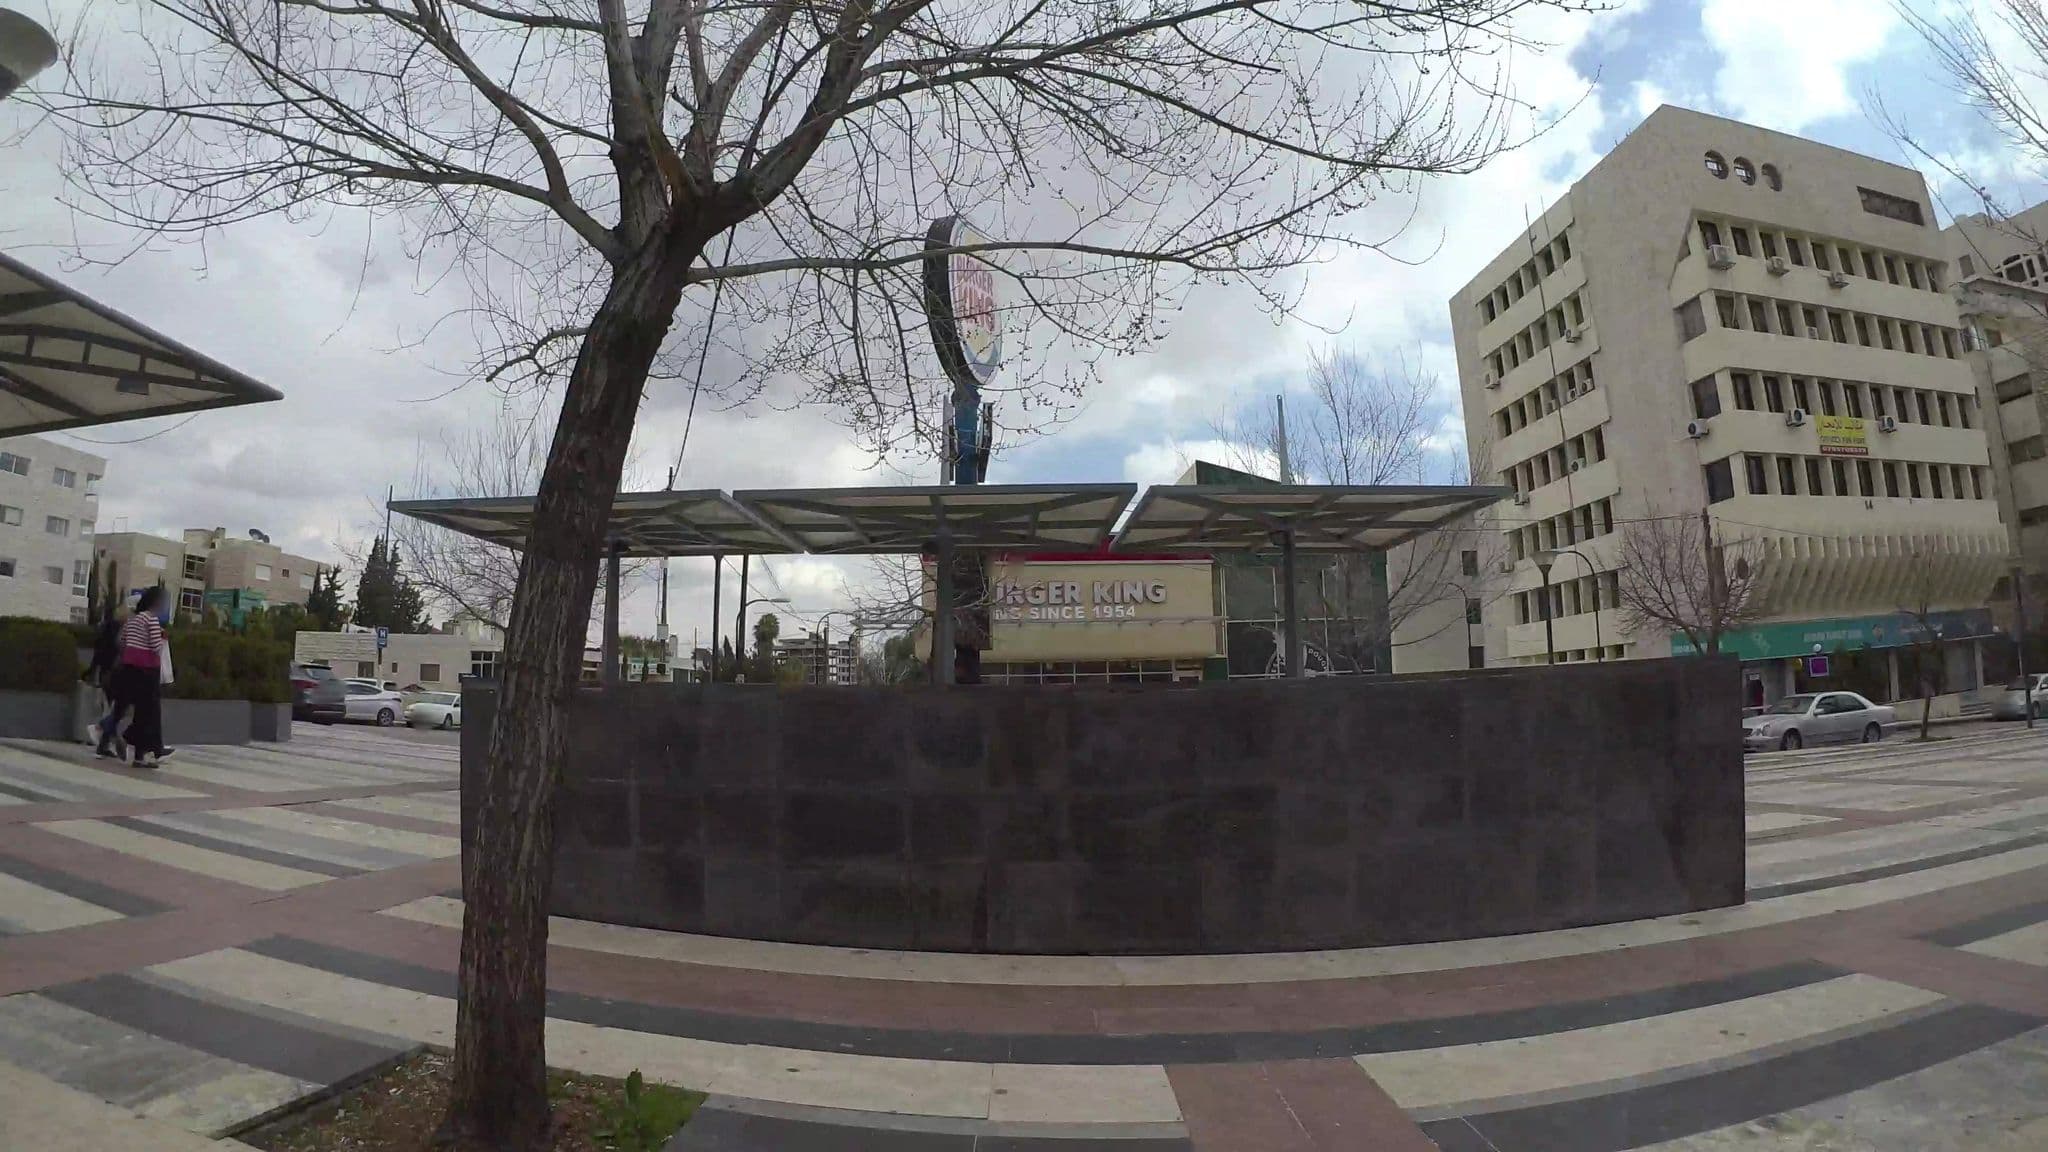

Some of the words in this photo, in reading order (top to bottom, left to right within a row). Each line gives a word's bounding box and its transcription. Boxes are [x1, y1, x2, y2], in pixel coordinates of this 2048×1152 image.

[1092, 580, 1167, 604] KING
[1029, 606, 1085, 620] SINCE
[1092, 606, 1136, 619] 1954
